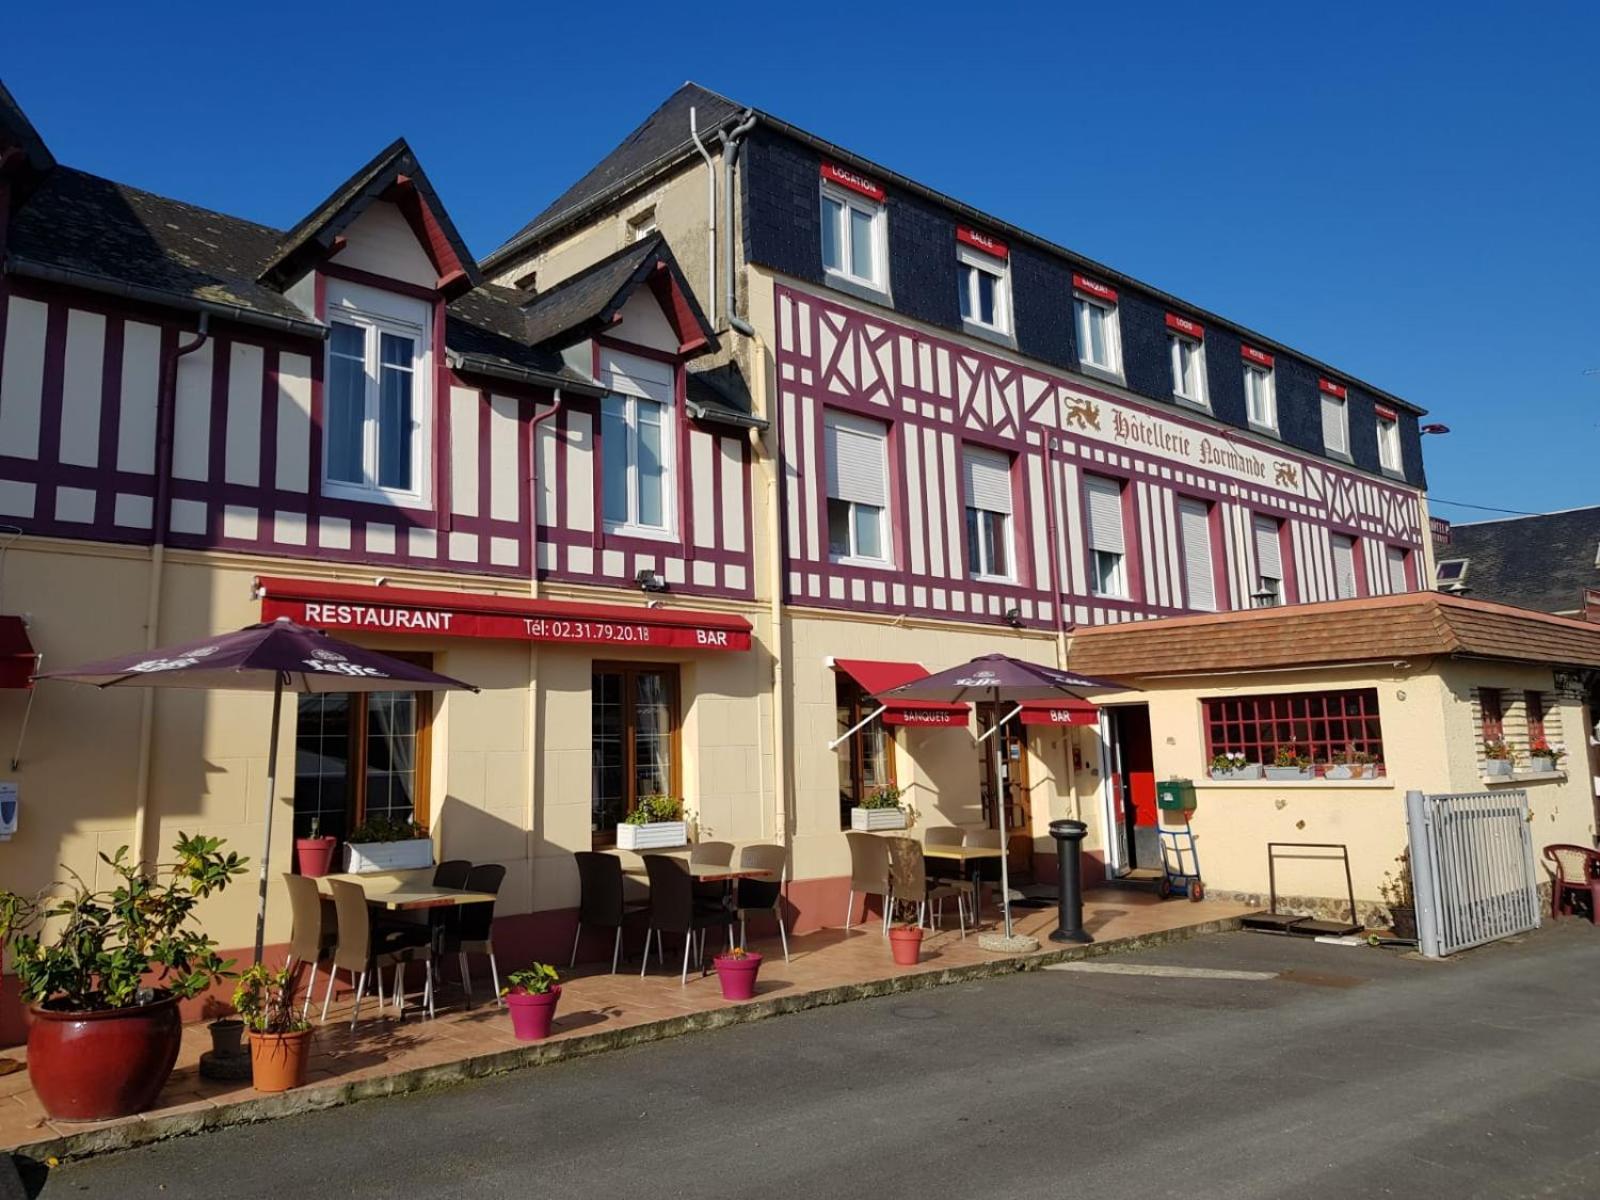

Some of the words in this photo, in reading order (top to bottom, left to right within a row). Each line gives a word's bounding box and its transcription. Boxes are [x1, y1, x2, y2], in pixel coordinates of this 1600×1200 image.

[832, 164, 877, 193] LOCATION
[970, 230, 993, 249] SALLE
[1112, 408, 1191, 458] Hôtellerie
[1199, 437, 1266, 479] Normande
[304, 603, 452, 631] RESTAURANT
[523, 617, 550, 638] Tél:
[552, 621, 650, 642] 02.31.79.20.18
[697, 629, 728, 647] BAR
[903, 710, 950, 722] BANQUETS
[1050, 710, 1073, 722] BAR
